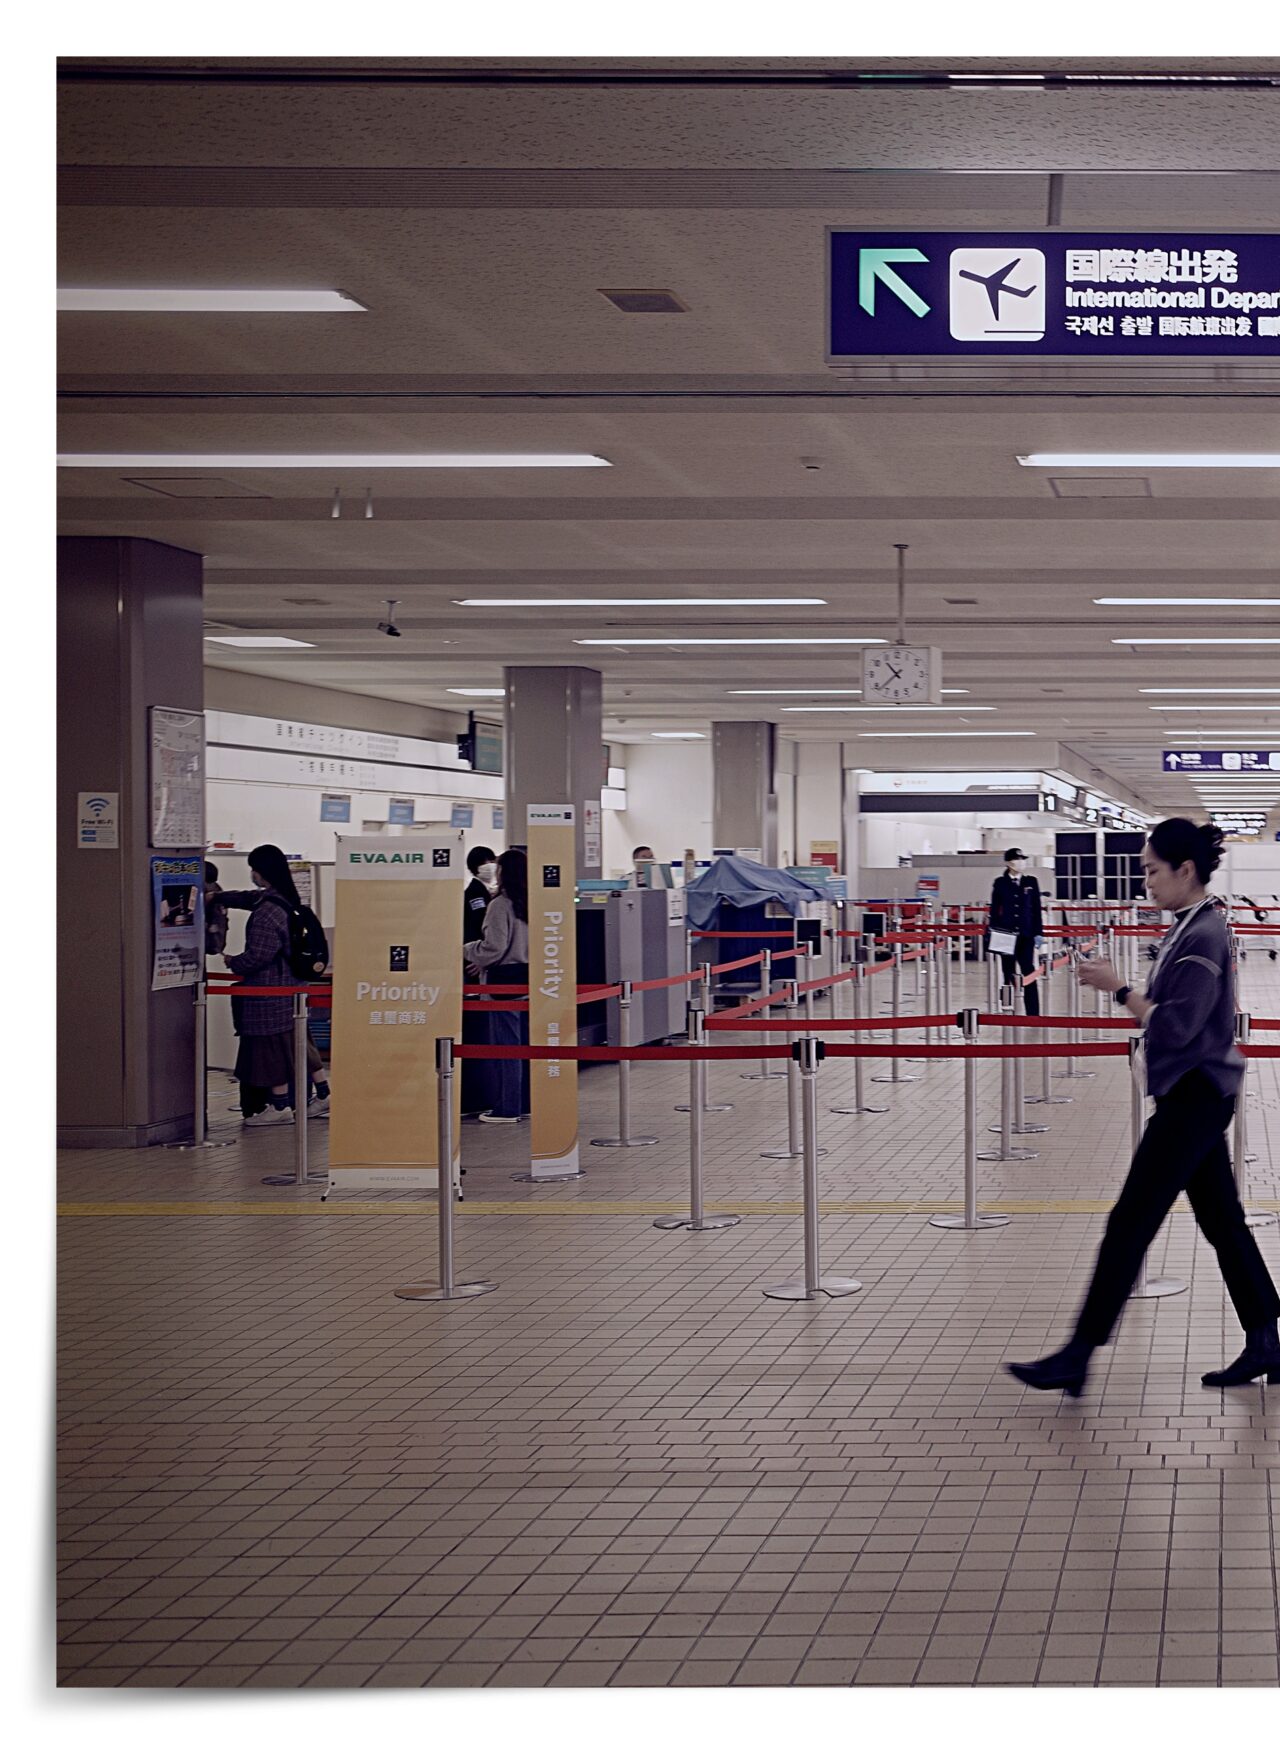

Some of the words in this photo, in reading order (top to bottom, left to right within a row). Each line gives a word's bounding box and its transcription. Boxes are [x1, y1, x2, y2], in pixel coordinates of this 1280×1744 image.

[1065, 249, 1239, 284] 国際線出発
[1065, 287, 1205, 309] International
[1064, 315, 1114, 336] 국제선
[1119, 315, 1154, 336] 출발
[1045, 795, 1055, 811] 1
[1086, 809, 1098, 822] 2
[539, 911, 564, 999] Priority
[356, 980, 440, 1006] Priority
